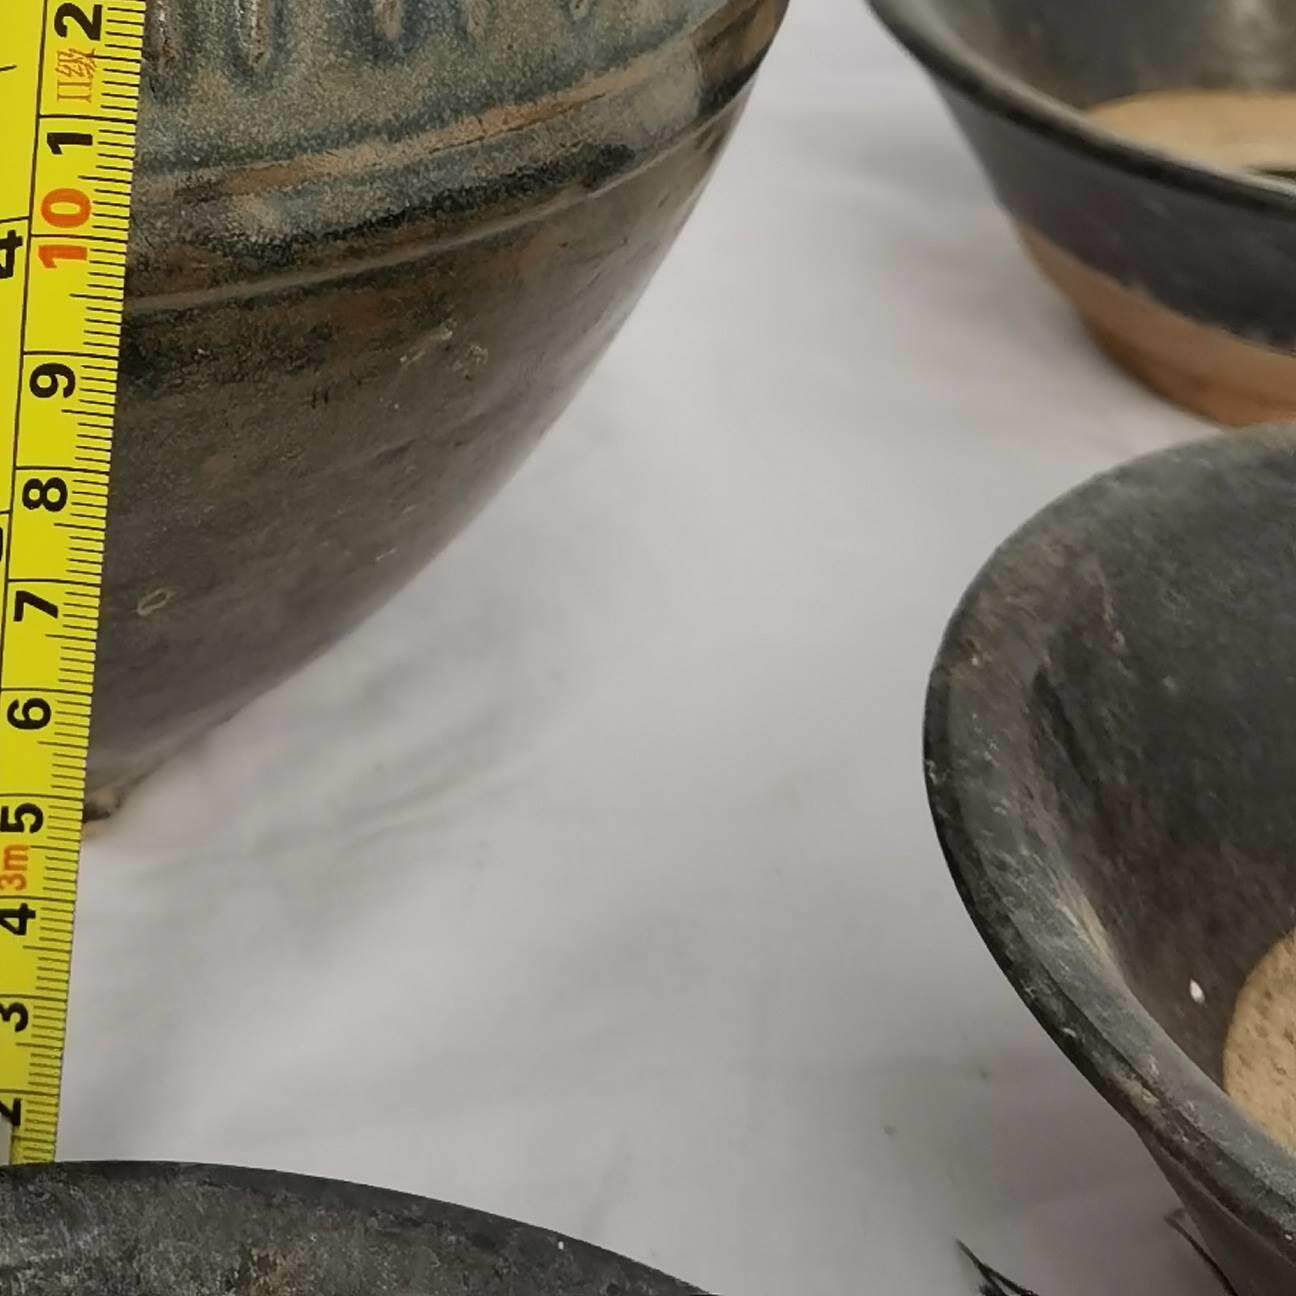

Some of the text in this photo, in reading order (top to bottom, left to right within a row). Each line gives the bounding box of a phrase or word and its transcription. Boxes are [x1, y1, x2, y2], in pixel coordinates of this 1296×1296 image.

[54, 2, 102, 41] 2
[46, 132, 93, 155] 1
[36, 188, 92, 269] 10
[29, 362, 76, 399] 9
[22, 477, 68, 512] 8
[13, 590, 59, 622] 7
[7, 697, 52, 730] 6
[0, 803, 44, 834] 5
